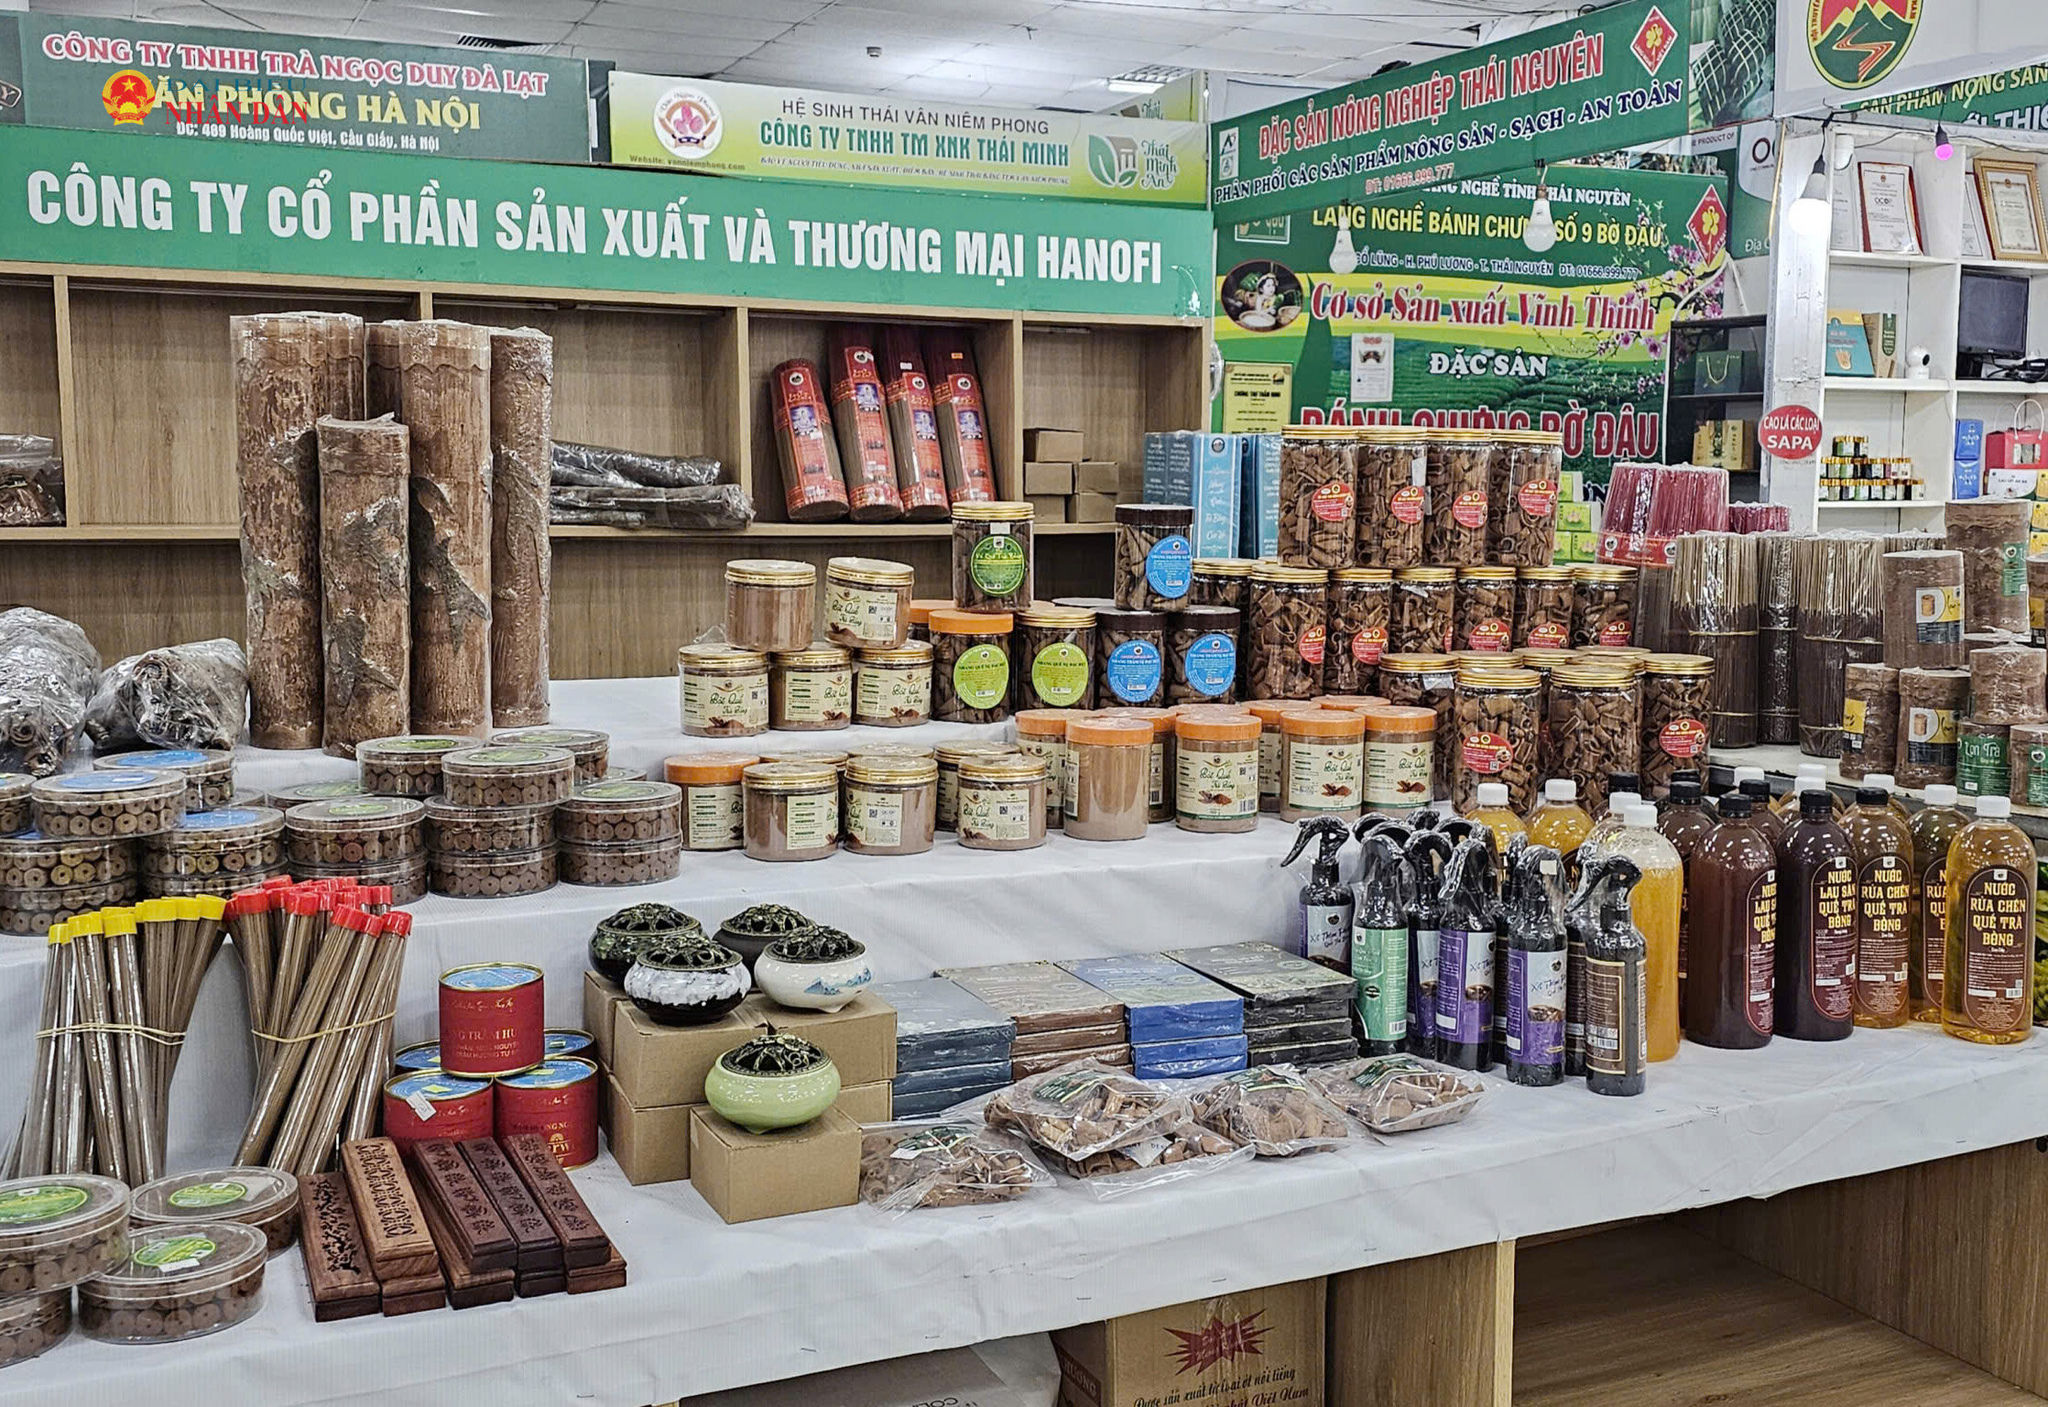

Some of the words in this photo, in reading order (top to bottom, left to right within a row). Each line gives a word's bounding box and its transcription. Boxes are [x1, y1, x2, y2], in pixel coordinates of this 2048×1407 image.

[42, 31, 133, 63] CÔNG
[136, 41, 175, 68] TY
[178, 43, 259, 74] TNHH
[262, 48, 318, 79] TRÀ
[321, 55, 403, 88] NGỌC
[407, 61, 460, 87] DUY
[462, 64, 502, 92] ĐÀ
[502, 70, 550, 99] LẠT
[1259, 115, 1291, 164] ĐẶC
[1293, 98, 1328, 152] SẢN
[1332, 95, 1382, 143] NÔNG
[1385, 74, 1455, 126] NGHIỆP
[1459, 54, 1507, 111] THÁI
[1510, 30, 1605, 98] NGUYÊN
[357, 91, 408, 125] HÀ
[415, 96, 481, 135] NỘI
[782, 97, 807, 118] HỆ
[812, 102, 854, 120] SINH
[859, 103, 900, 124] THÁI
[905, 106, 940, 127] VÂN
[945, 111, 986, 131] NIÊM
[991, 117, 1050, 135] PHONG
[230, 123, 270, 142] Hoàng
[273, 126, 305, 143] Quốc
[340, 128, 364, 147] Cầu
[400, 135, 417, 150] Hà
[420, 136, 440, 153] Nội
[759, 117, 812, 149] CÔNG
[818, 125, 842, 151] TY
[846, 127, 896, 156] TNHH
[901, 132, 928, 157] TM
[935, 134, 971, 160] XNK
[976, 135, 1017, 164] THÁI
[1022, 141, 1070, 168] MINH
[1141, 139, 1170, 160] Thái
[1215, 176, 1251, 204] PHÂN
[1254, 166, 1287, 196] PHỐI
[1288, 164, 1318, 186] CÁC
[1320, 153, 1352, 180] SẢN
[1355, 139, 1401, 174] PHẨM
[1403, 134, 1454, 162] NÔNG
[1457, 121, 1497, 151] SẢN
[1510, 108, 1565, 142] SẠCH
[1579, 96, 1612, 124] AN
[1615, 78, 1684, 115] TOÀN
[1146, 156, 1178, 181] Minh
[1460, 175, 1501, 198] NGHỀ
[1502, 181, 1537, 200] TỈNH
[1545, 182, 1574, 202] HÁI
[1576, 186, 1632, 207] NGUYÊN
[27, 162, 173, 231] CÔNG
[190, 180, 249, 235] TY
[267, 168, 333, 240] CỔ
[350, 179, 479, 249] PHẦN
[495, 186, 587, 254] SẢN
[602, 196, 712, 261] XUẤT
[723, 208, 777, 265] VÀ
[788, 219, 943, 274] THƯƠNG
[955, 230, 1025, 287] MẠI
[1038, 236, 1163, 284] HANOFI
[1371, 201, 1425, 232] NGHỀ
[1428, 206, 1480, 238] BÁNH
[1555, 212, 1579, 243] SỐ
[1581, 222, 1592, 244] 9
[1597, 219, 1621, 246] BỜ
[1624, 222, 1663, 248] ĐẬU
[1745, 238, 1762, 254] Địa
[1439, 254, 1474, 272] LƯƠNG
[1491, 258, 1514, 275] THÁI
[1513, 258, 1554, 277] NGUYÊN
[1311, 282, 1348, 320] Cơ
[1353, 282, 1384, 320] sở
[1391, 283, 1442, 322] Sản
[1452, 284, 1508, 326] xuất
[1518, 292, 1577, 328] Vĩnh
[1429, 346, 1489, 381] ĐẶC
[1493, 346, 1549, 378] SẢN
[1592, 402, 1660, 464] ĐẬU
[1763, 415, 1780, 430] CAO
[1767, 434, 1814, 451] SAPA
[1874, 868, 1902, 883] NƯỚC
[1819, 885, 1840, 900] LAU
[1861, 883, 1884, 899] RỬA
[1983, 881, 2016, 896] NƯỚC
[1863, 899, 1887, 919] QUẾ
[1970, 896, 1995, 913] RỬA
[1997, 898, 2026, 913] CHÉN
[1972, 912, 1997, 932] QUẾ
[1999, 914, 2023, 931] TRÀ
[1982, 930, 2015, 947] BỒNG
